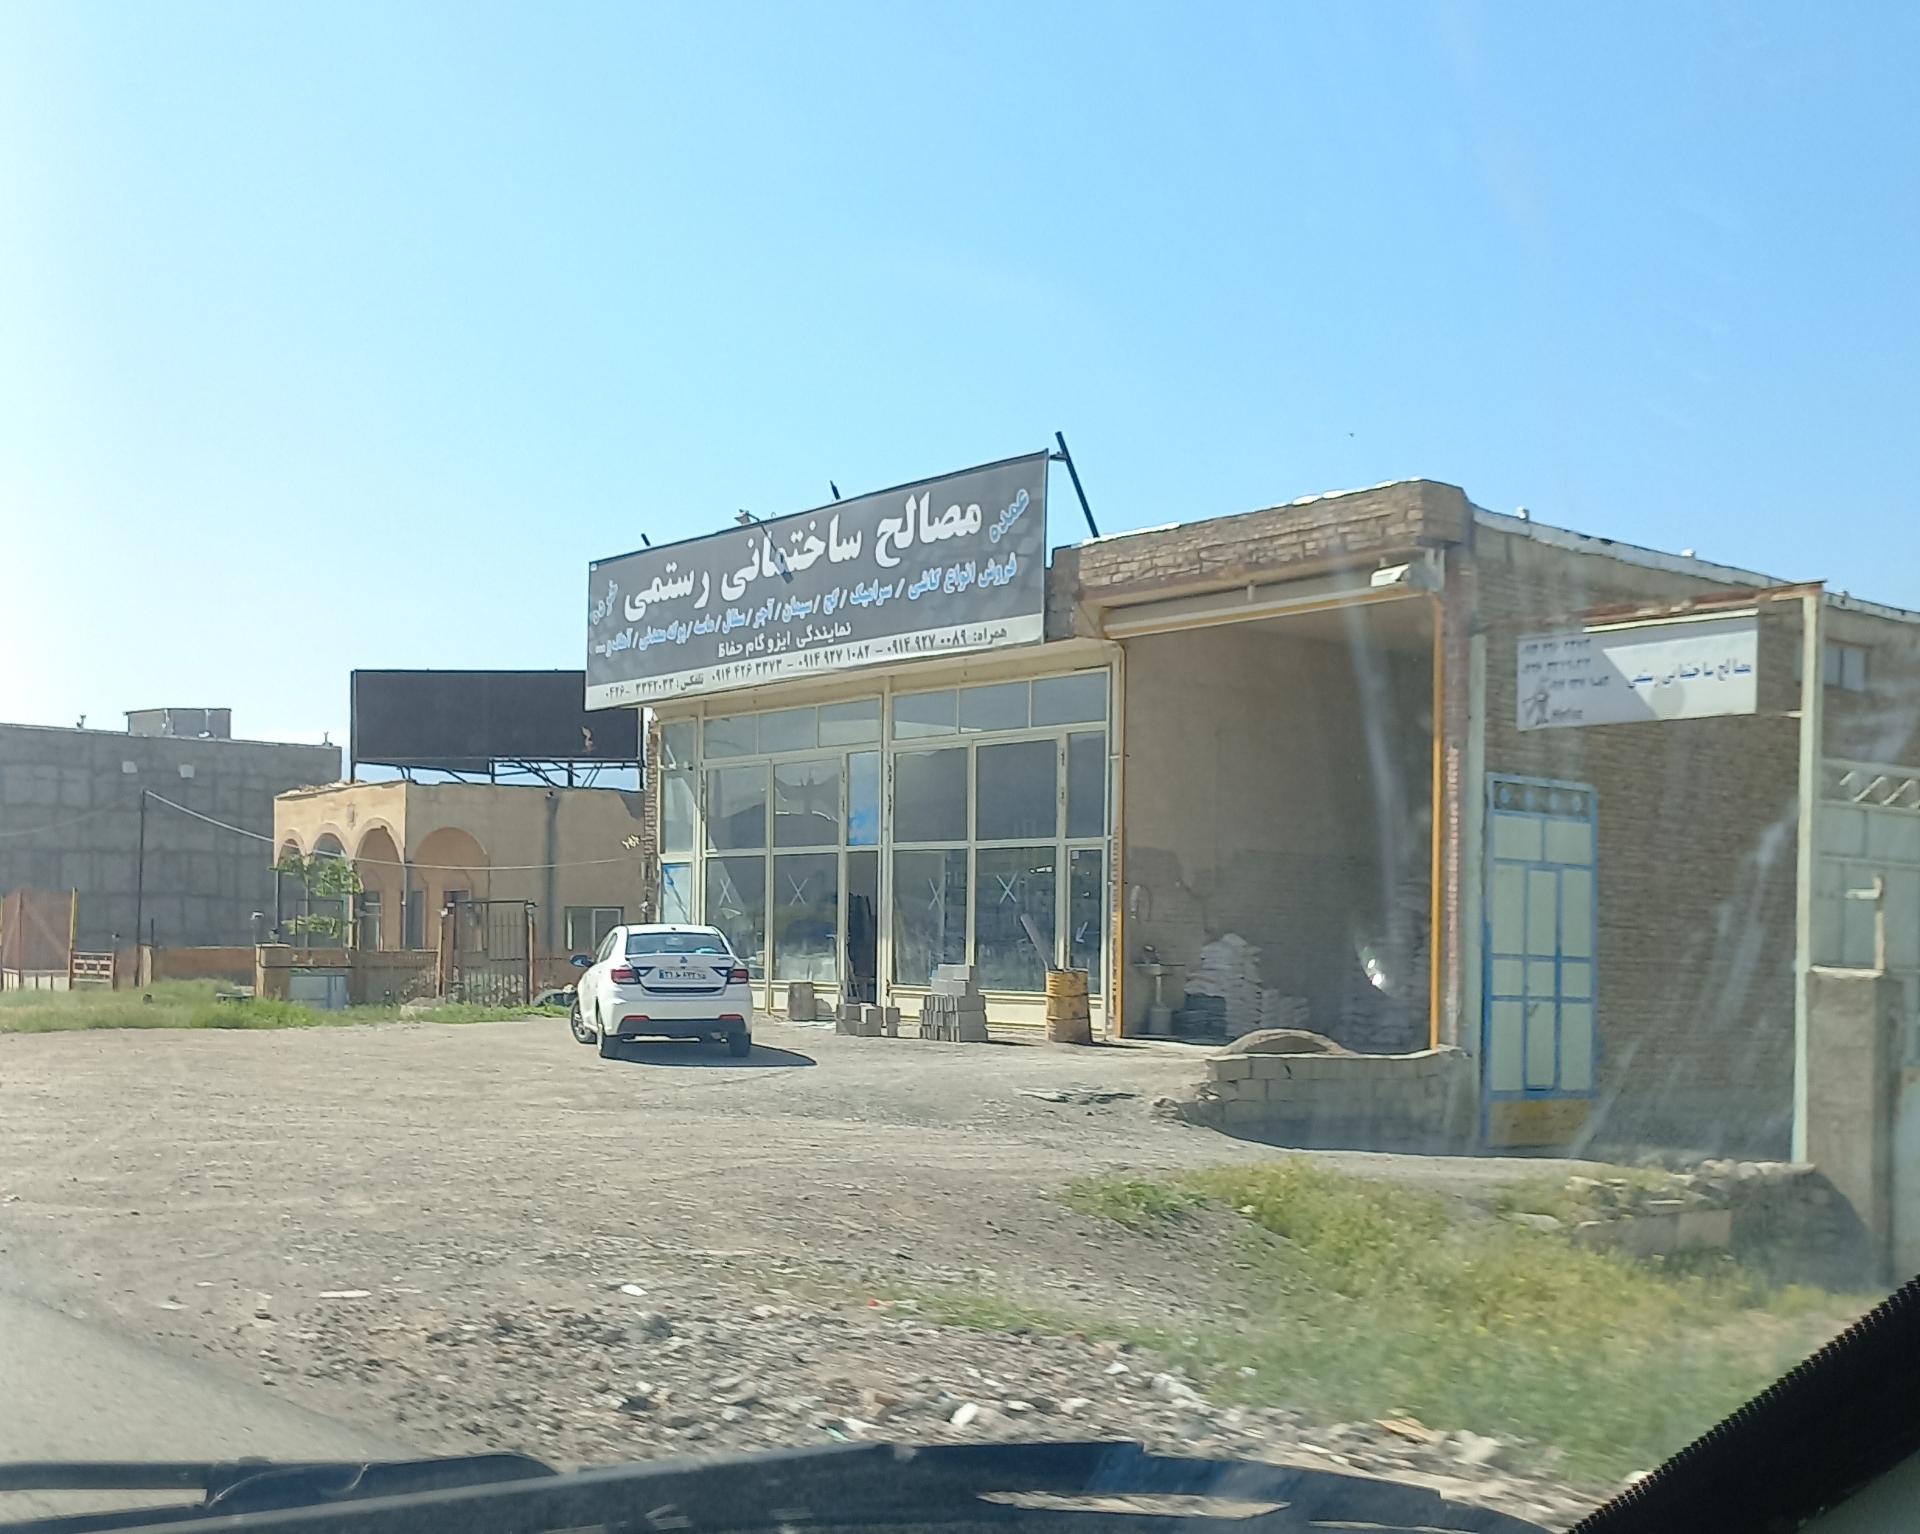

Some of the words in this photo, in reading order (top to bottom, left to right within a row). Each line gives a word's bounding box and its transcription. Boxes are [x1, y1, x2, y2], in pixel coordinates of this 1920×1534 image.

[875, 491, 982, 568] مصالح
[988, 488, 1030, 543] عمده
[721, 512, 863, 602] ساختمانی
[978, 551, 1018, 589] فروش
[624, 561, 710, 622] رستمی
[850, 578, 893, 608] سرامیک
[908, 567, 943, 600] کاشی
[943, 560, 977, 594] انواع
[753, 597, 776, 629] آجر
[782, 595, 814, 623] سیمان
[823, 586, 840, 615] گچ
[795, 621, 852, 648] نمایندگی
